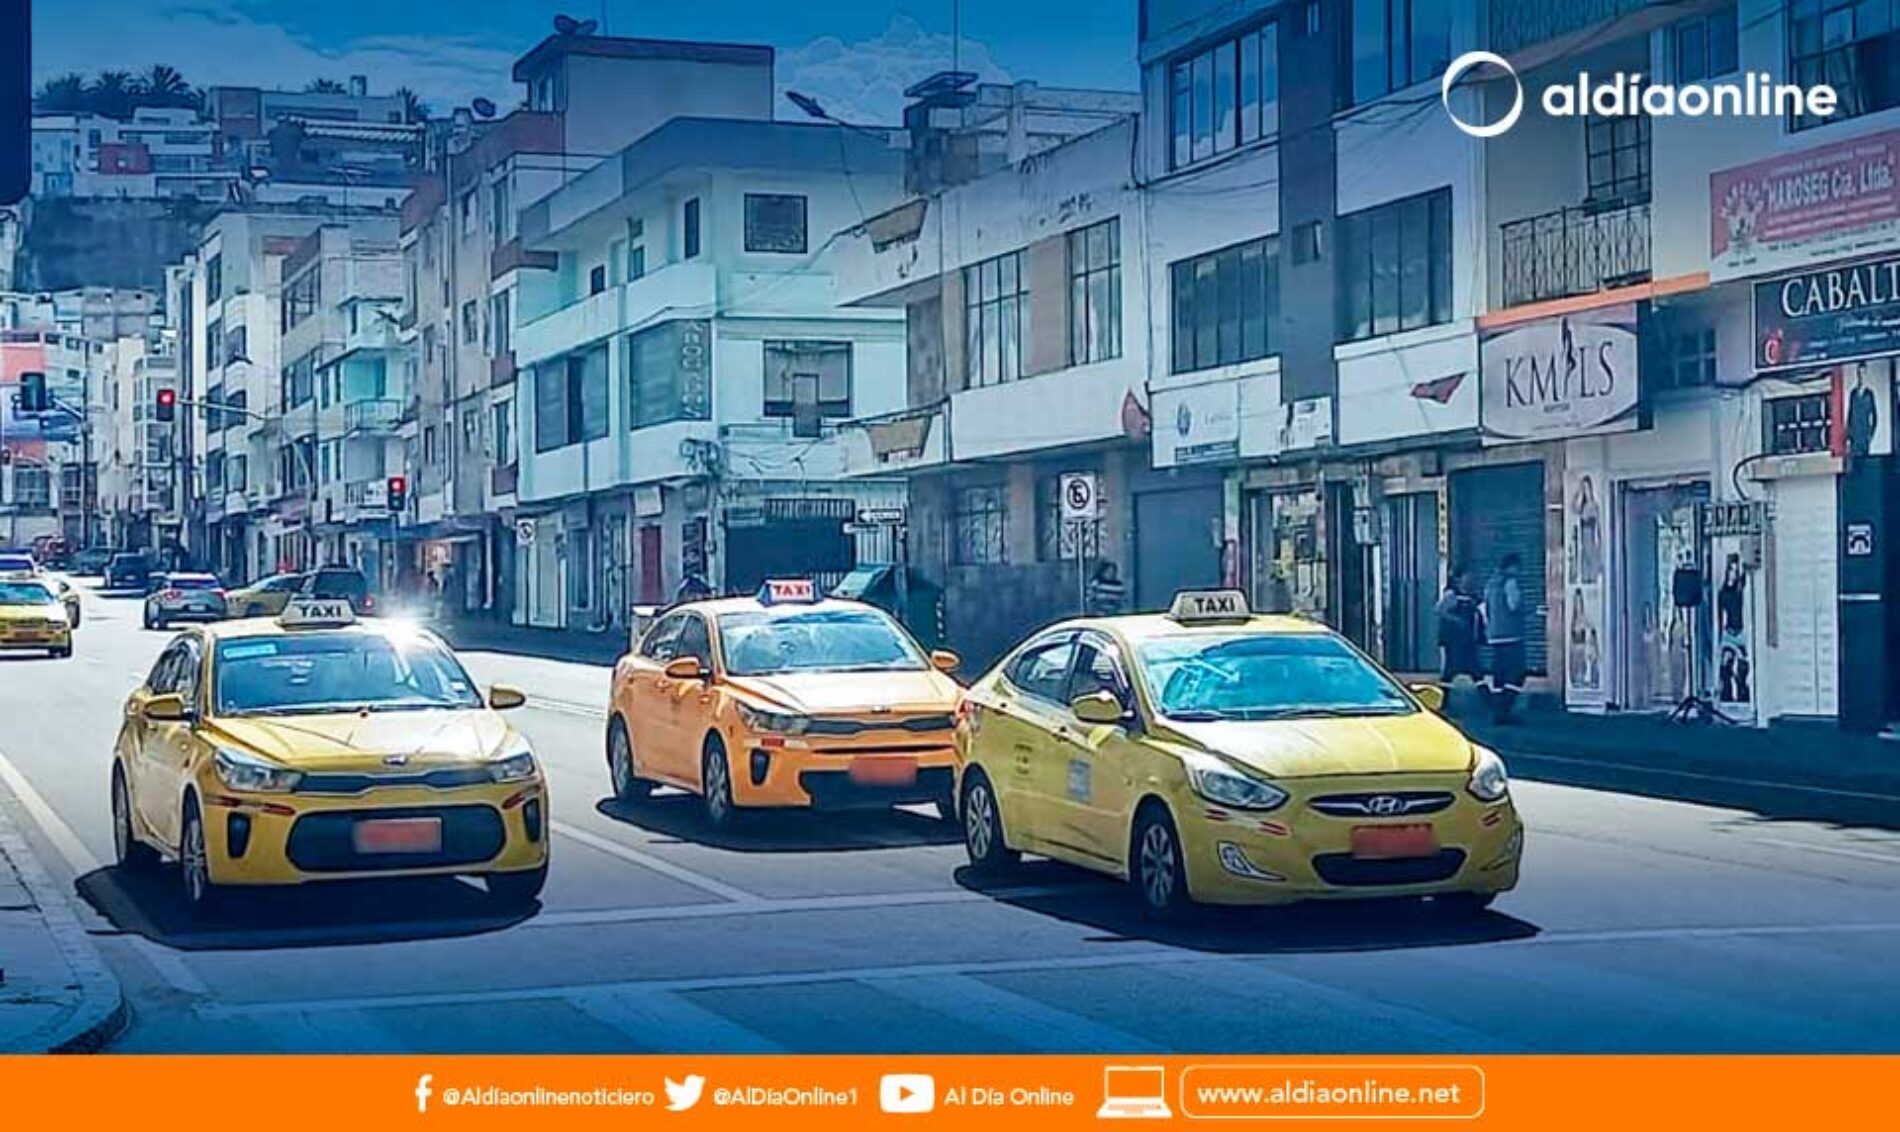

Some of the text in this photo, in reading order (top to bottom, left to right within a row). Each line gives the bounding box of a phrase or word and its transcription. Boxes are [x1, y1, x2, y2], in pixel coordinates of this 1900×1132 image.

[772, 584, 810, 596] TAXI
[301, 605, 342, 618] TAXI
[1194, 597, 1236, 613] TAXI
